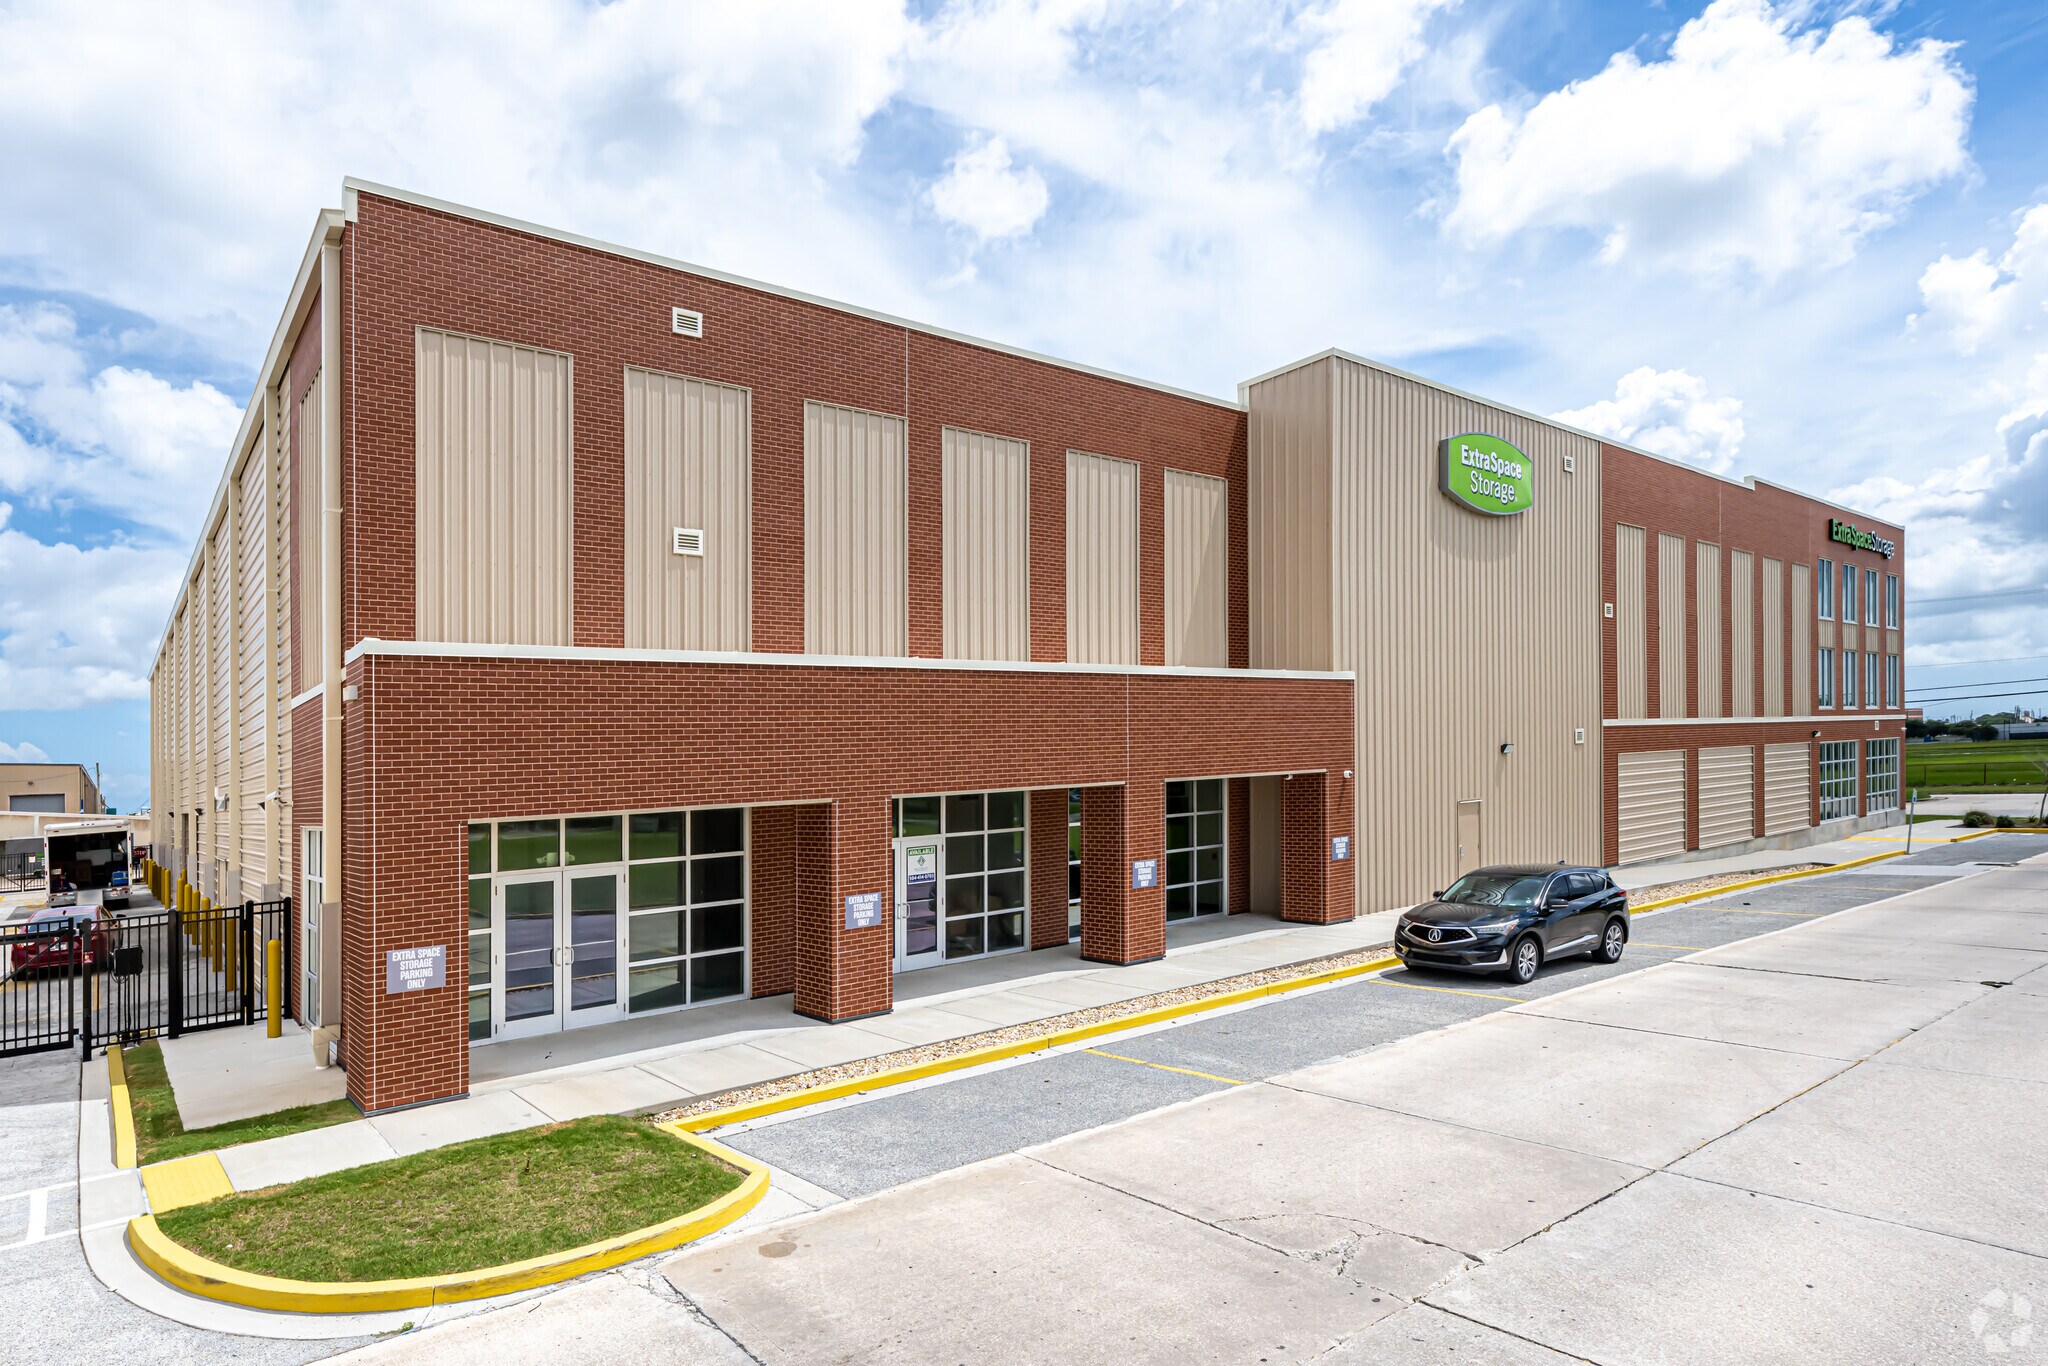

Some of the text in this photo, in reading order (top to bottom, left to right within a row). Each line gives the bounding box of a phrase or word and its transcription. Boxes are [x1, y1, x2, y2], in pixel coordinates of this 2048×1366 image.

[1461, 444, 1522, 480] ExtraSpace
[1470, 470, 1515, 504] Storage
[909, 847, 934, 855] AVAILABLE
[848, 893, 878, 904] EXTRA SPACE
[853, 902, 874, 911] STORAGE
[853, 909, 874, 919] PARKING
[857, 918, 870, 927] ONLY
[392, 947, 441, 962] EXTRA SPACE
[400, 958, 433, 971] STORAGE
[400, 967, 433, 981] PARKING
[407, 978, 426, 990] ONLY
